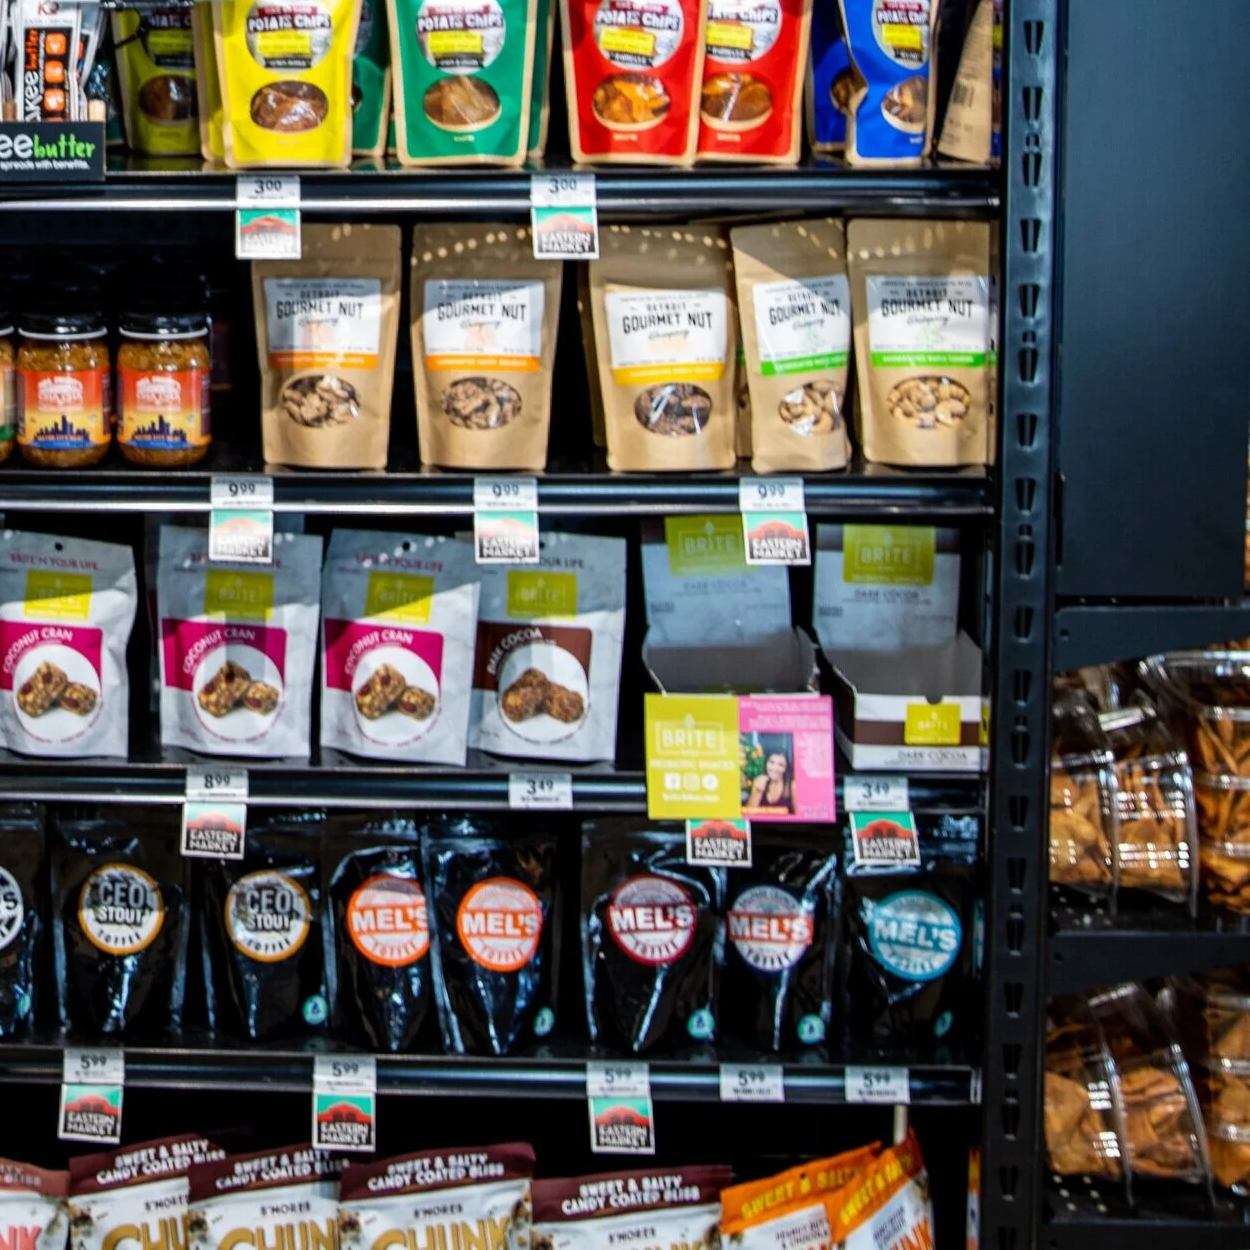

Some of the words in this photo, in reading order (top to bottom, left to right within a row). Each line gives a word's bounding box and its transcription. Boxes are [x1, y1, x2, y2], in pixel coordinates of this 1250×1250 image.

[276, 300, 332, 321] GOURMET
[338, 302, 363, 319] NUT
[438, 302, 495, 322] GOURMET
[501, 303, 526, 321] NUT
[881, 297, 941, 319] GOURMET
[946, 298, 974, 318] NUT
[622, 312, 682, 335] GOURMET
[688, 311, 713, 330] NUT
[40, 627, 73, 642] CRAN
[381, 629, 413, 644] CRAN
[502, 627, 543, 650] COCOA
[662, 730, 716, 749] BRITE
[189, 830, 239, 842] EASTERN
[189, 840, 237, 853] MARKET
[693, 839, 744, 850] EASTERN
[859, 838, 912, 850] EASTERN
[693, 848, 743, 860] MARKET
[860, 848, 912, 860] MARKET
[99, 881, 144, 906] CEO
[247, 886, 292, 915] CEO
[97, 905, 145, 925] STOUT
[247, 911, 292, 932] STOUT
[352, 905, 429, 934] MEL'S
[461, 911, 538, 936] MEL'S
[611, 905, 693, 932] MEL'S
[729, 915, 809, 941] MEL'S
[873, 921, 957, 949] MEL'S
[320, 1123, 368, 1135] EASTERN
[321, 1133, 368, 1145] MARKET
[368, 1174, 413, 1190] CANDY
[416, 1168, 467, 1184] COATED
[561, 1197, 605, 1216] CANDY
[609, 1192, 660, 1208] COATED
